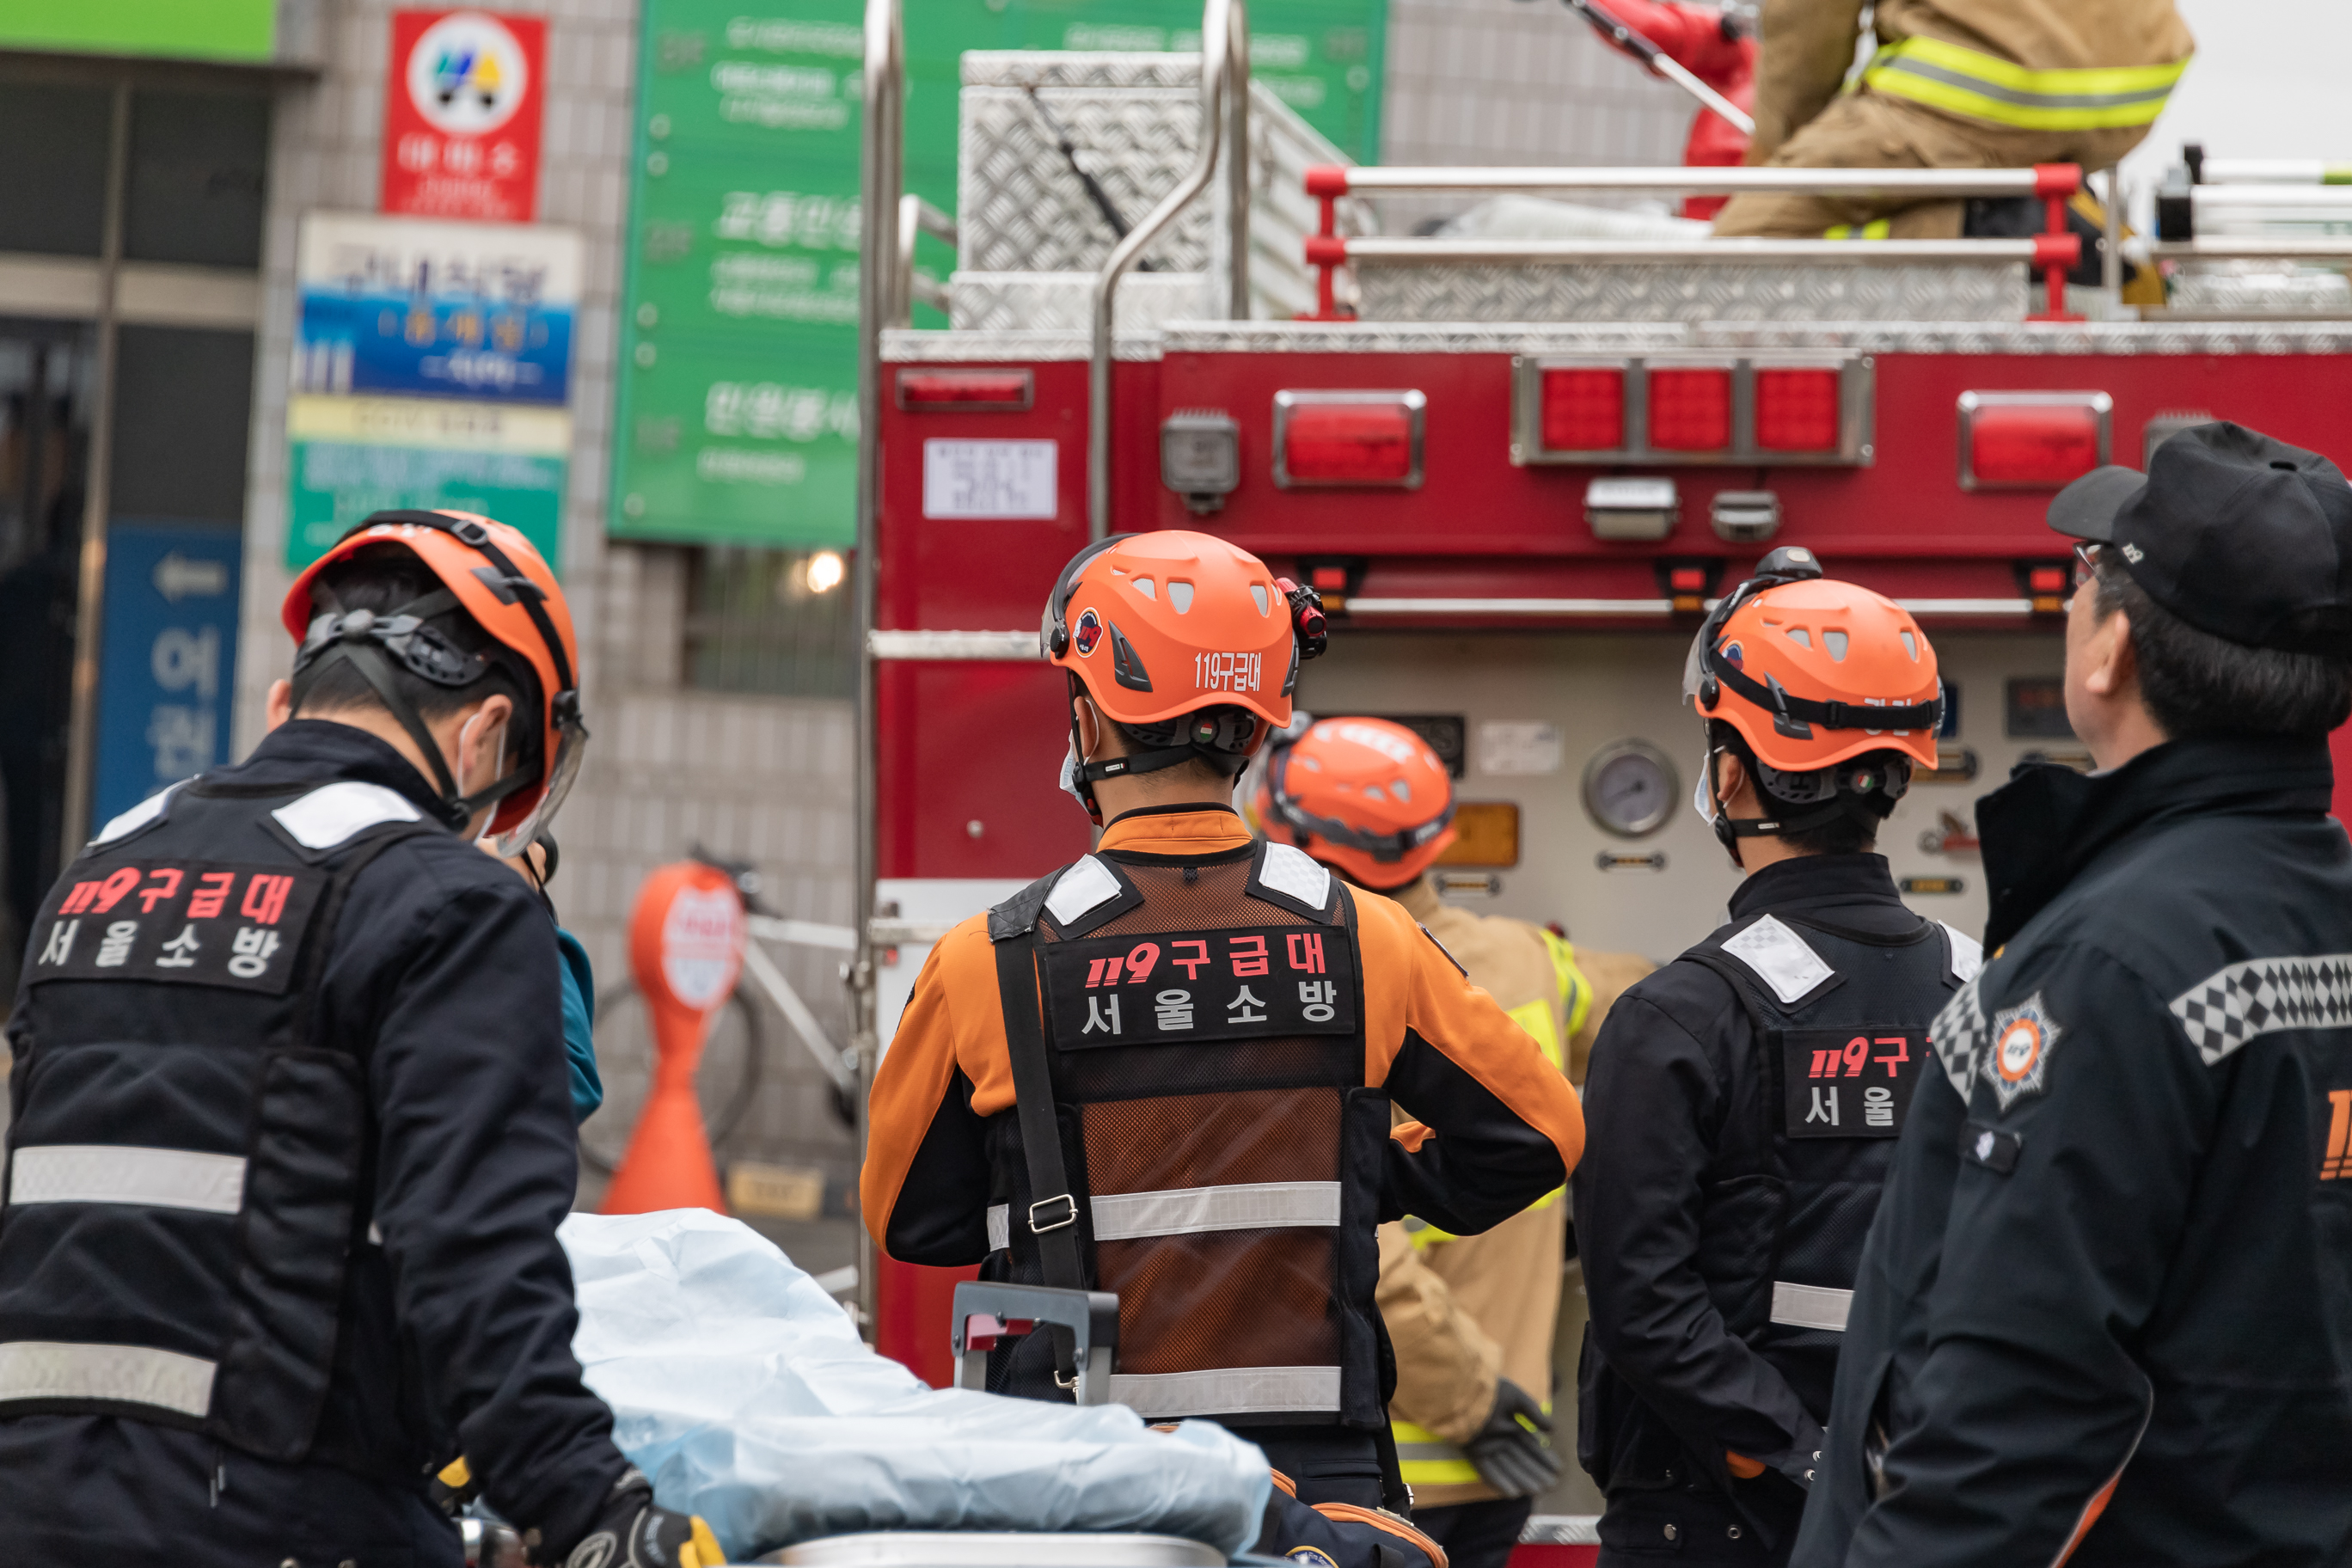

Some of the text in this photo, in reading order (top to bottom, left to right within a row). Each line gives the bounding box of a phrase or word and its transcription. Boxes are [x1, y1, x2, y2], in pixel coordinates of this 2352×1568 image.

[1195, 652, 1261, 691] 119구급대
[39, 919, 280, 978] 서울소방
[1081, 981, 1337, 1034] 서울소방
[1805, 1086, 1894, 1126] 서울
